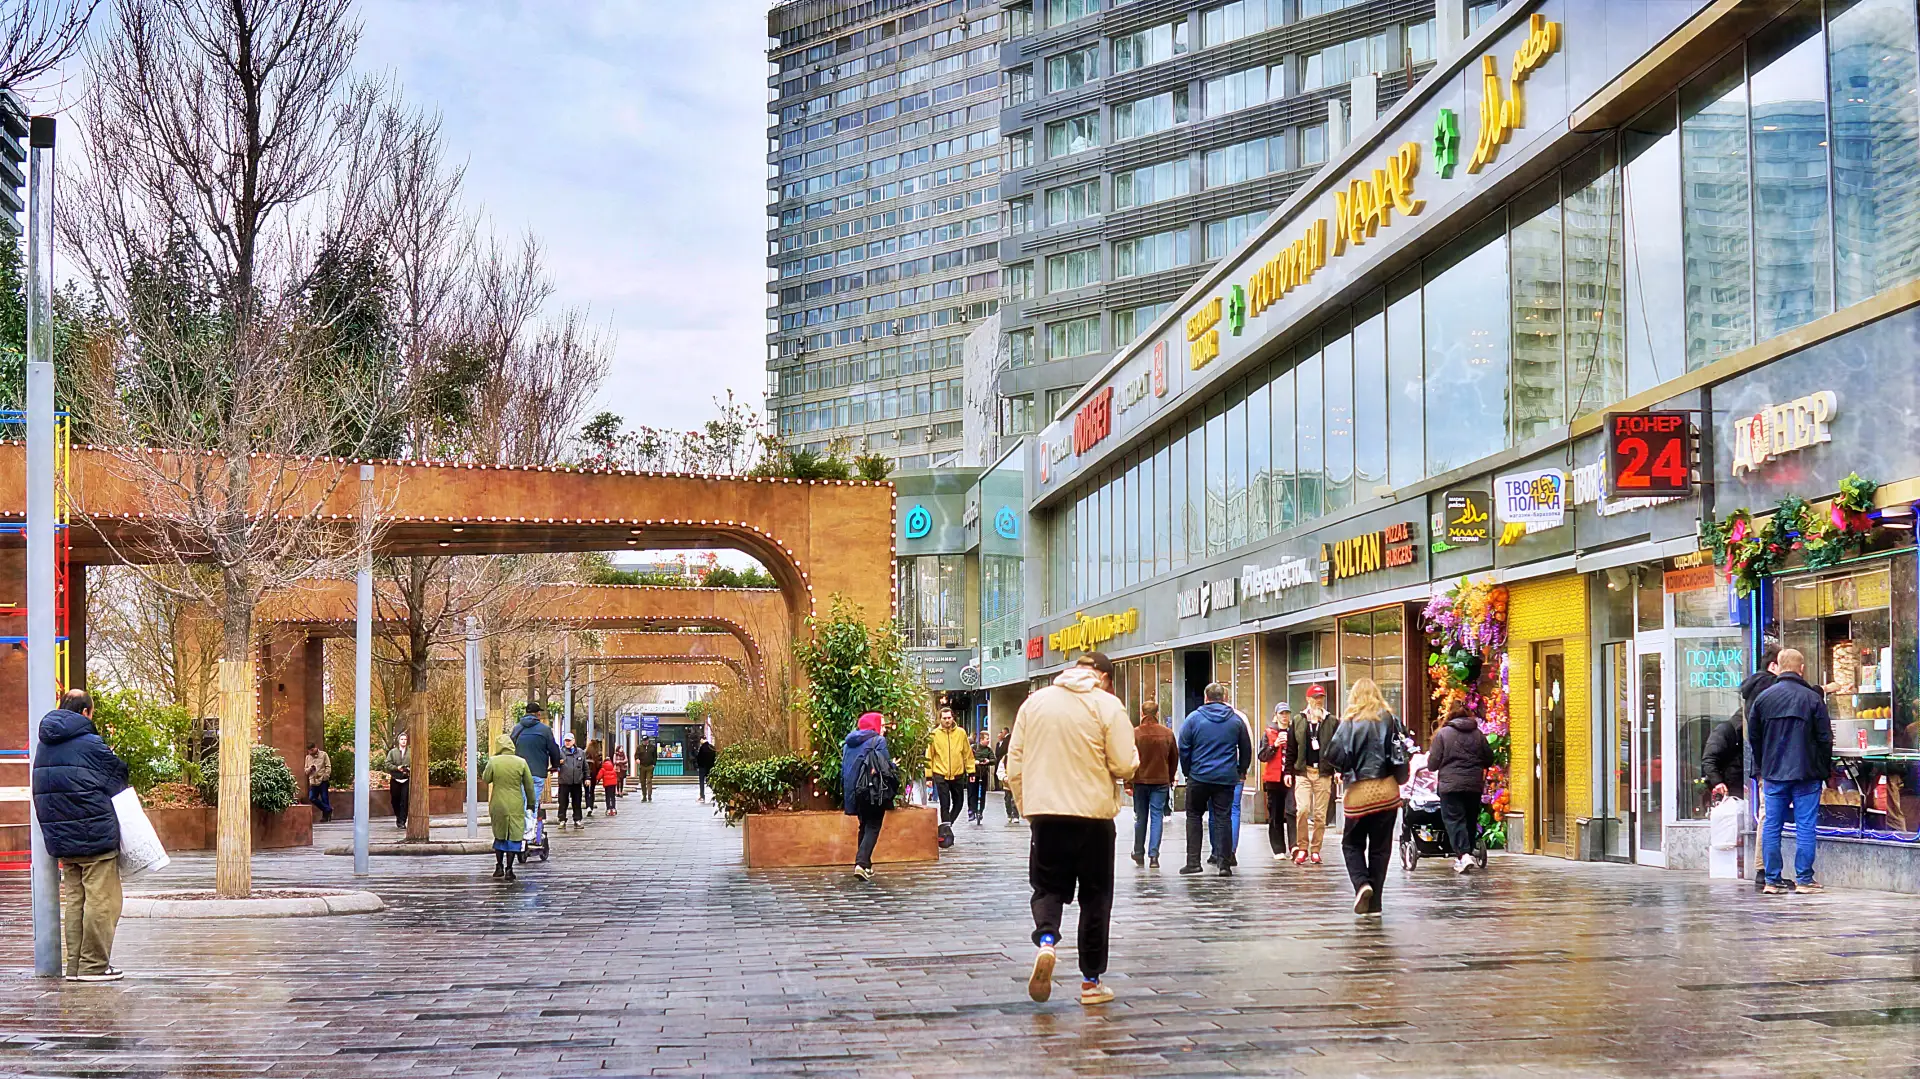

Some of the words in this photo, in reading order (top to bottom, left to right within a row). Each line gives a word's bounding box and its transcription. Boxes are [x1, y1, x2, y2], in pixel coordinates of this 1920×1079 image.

[1248, 219, 1327, 317] РЕСТОРАН
[1331, 142, 1426, 257] МАДАР
[1073, 387, 1113, 457] ФОНБЕТ
[1615, 416, 1682, 436] ДОНЕР
[1616, 437, 1687, 488] 24
[1505, 479, 1540, 496] ТВОЯ
[1508, 493, 1560, 512] ПОЛКА
[1385, 524, 1402, 544] PIZZA
[1448, 528, 1488, 538] МАДАР
[1334, 531, 1381, 580] SULTAN
[1385, 545, 1414, 568] BURGERS
[1674, 551, 1703, 570] ОДЕЖДА
